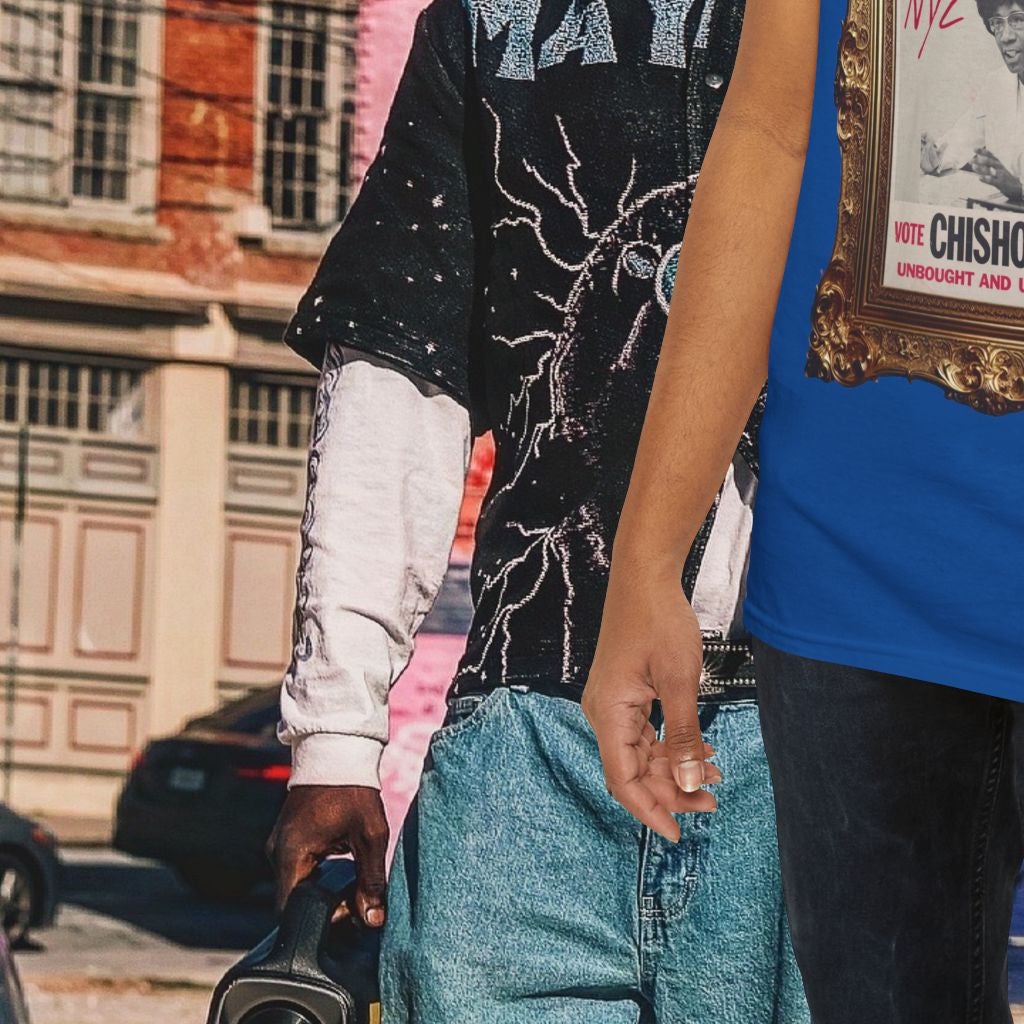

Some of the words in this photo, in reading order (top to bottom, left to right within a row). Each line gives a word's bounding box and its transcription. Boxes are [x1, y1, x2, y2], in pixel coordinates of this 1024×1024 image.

[894, 220, 925, 247] VOTE
[897, 261, 975, 287] UNBOUGHT
[979, 273, 1012, 292] AND
